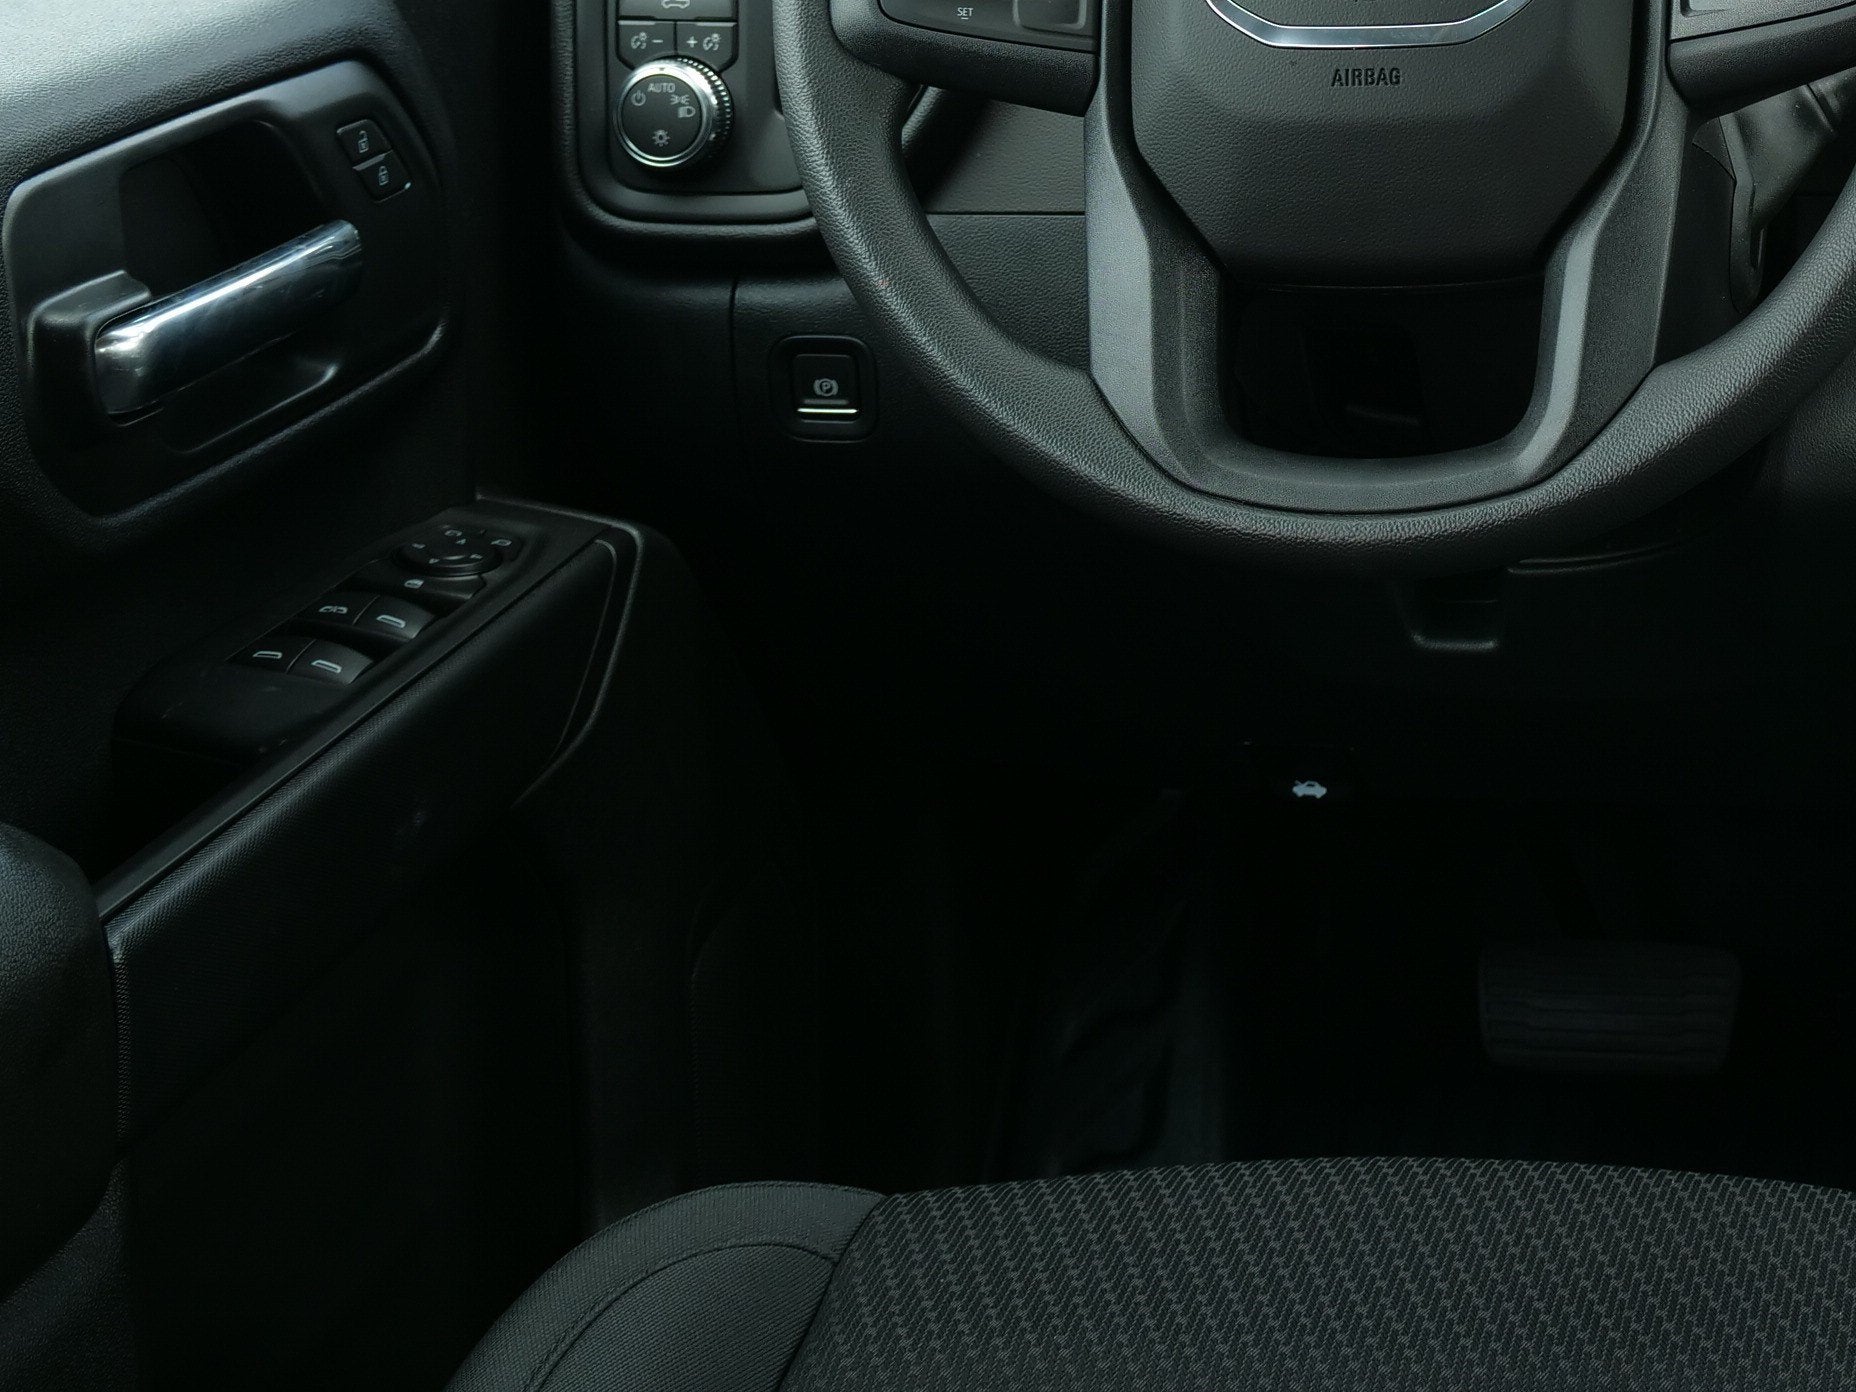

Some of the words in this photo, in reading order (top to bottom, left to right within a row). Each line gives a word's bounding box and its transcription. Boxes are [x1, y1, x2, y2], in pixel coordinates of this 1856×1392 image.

[957, 7, 974, 17] SET
[1330, 67, 1401, 88] AIRBAG
[647, 81, 676, 94] AUTO
